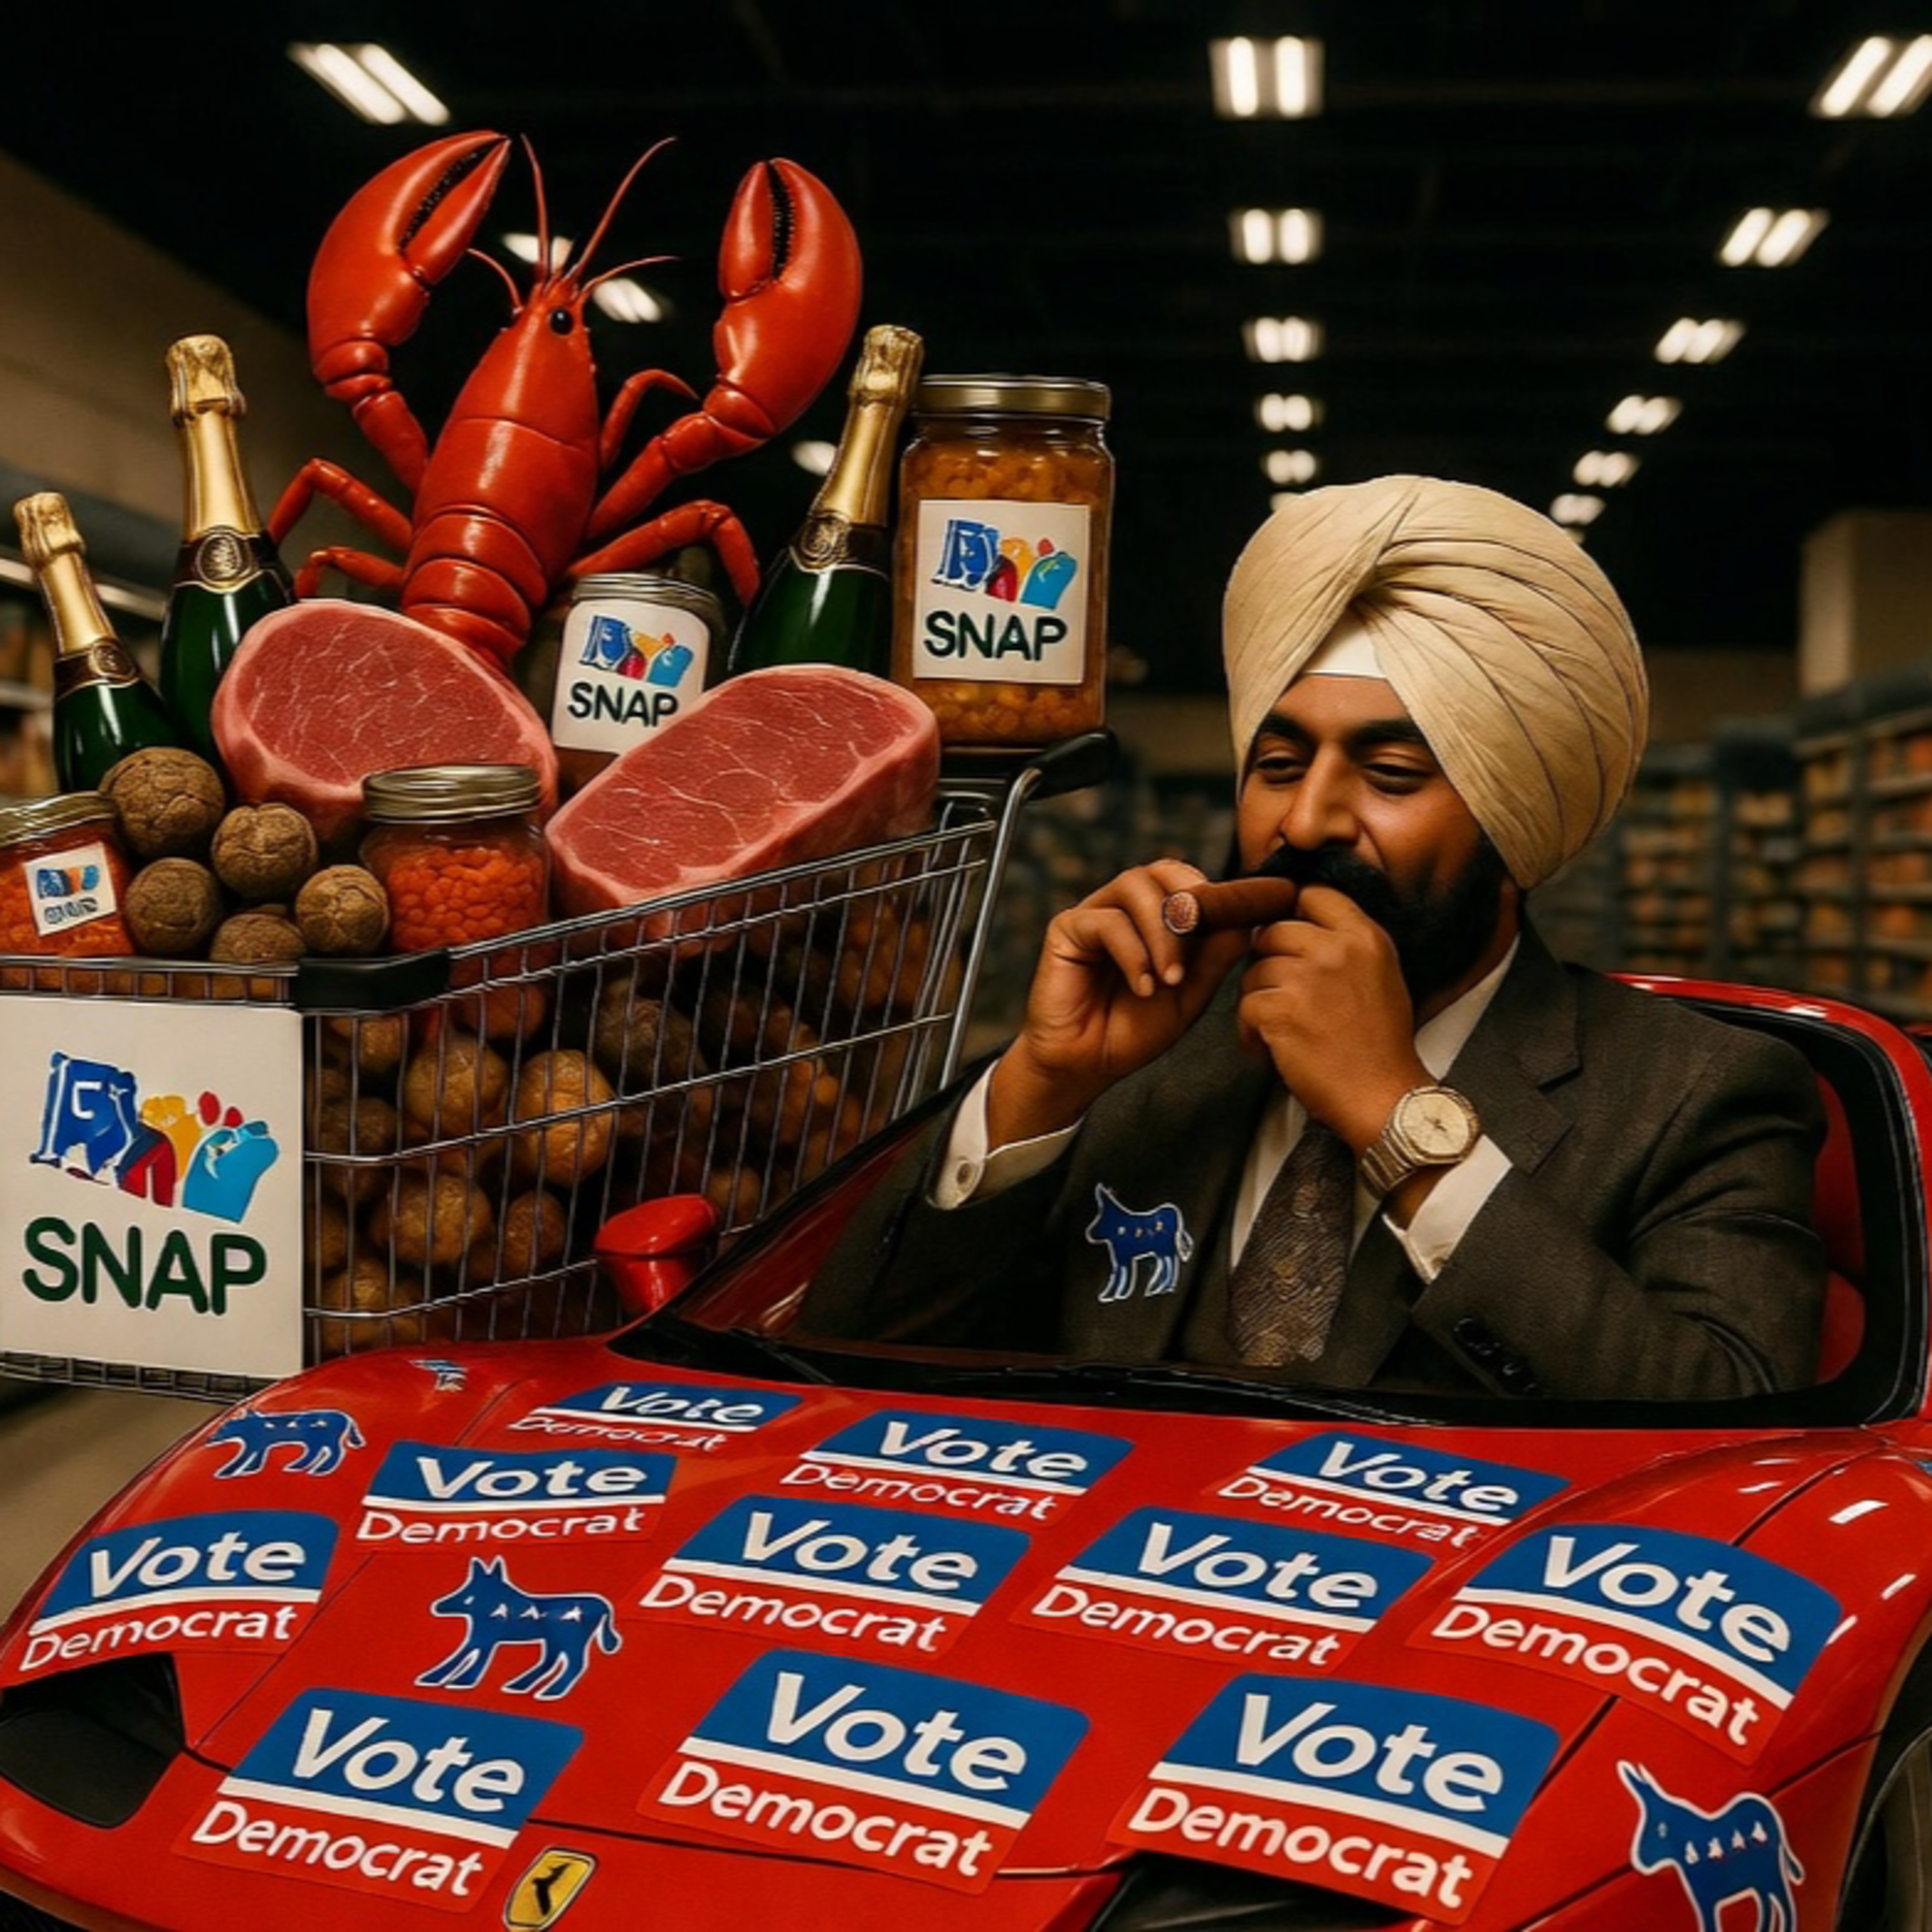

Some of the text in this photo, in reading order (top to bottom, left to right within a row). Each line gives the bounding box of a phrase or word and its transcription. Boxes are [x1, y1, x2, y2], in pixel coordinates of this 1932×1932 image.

[923, 611, 1067, 661] SNAP
[567, 681, 679, 727] SNAP
[23, 1217, 267, 1315] SNAP
[600, 1386, 764, 1423] Vote
[417, 1456, 647, 1499] Vote
[880, 1421, 1088, 1477] Vote
[1319, 1441, 1519, 1511] Vote
[356, 1506, 645, 1544] Democrat
[781, 1463, 1057, 1520] Democrat
[1218, 1475, 1479, 1548] Democrat
[90, 1531, 306, 1598] Vote
[743, 1511, 978, 1590] Vote
[1138, 1522, 1378, 1609] Vote
[639, 1574, 947, 1652] Democrat
[1032, 1585, 1340, 1665] Democrat
[1544, 1535, 1790, 1662] Vote
[19, 1607, 296, 1671] Democrat
[1432, 1604, 1760, 1746] Democrat
[293, 1709, 524, 1812] Vote
[767, 1672, 1027, 1790] Vote
[1236, 1693, 1503, 1812] Vote
[192, 1801, 483, 1896] Democrat
[658, 1761, 992, 1877] Democrat
[1128, 1788, 1473, 1909] Democrat
